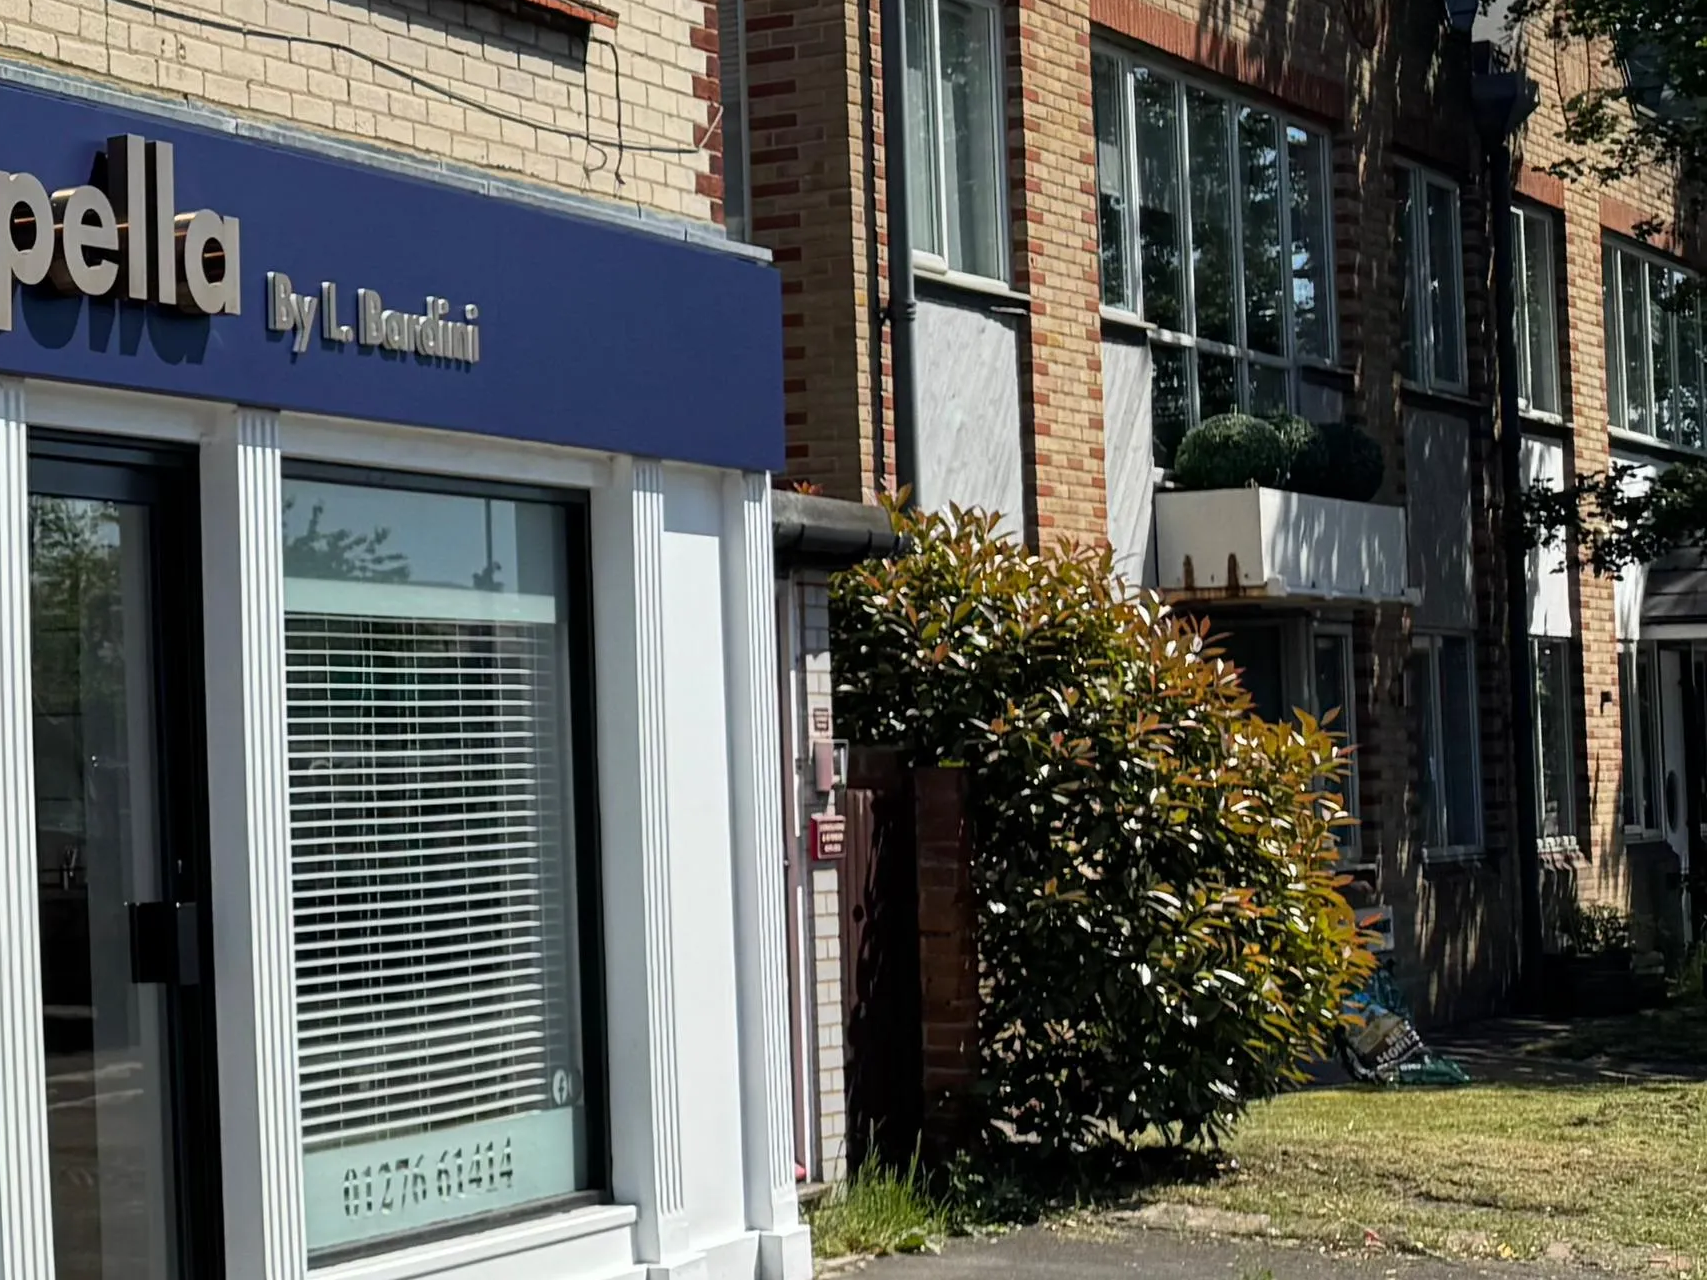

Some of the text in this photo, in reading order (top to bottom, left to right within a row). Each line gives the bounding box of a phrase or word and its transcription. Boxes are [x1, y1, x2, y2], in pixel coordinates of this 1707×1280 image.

[267, 271, 480, 364] By L. Bardini
[343, 1136, 513, 1219] 01276 61414
